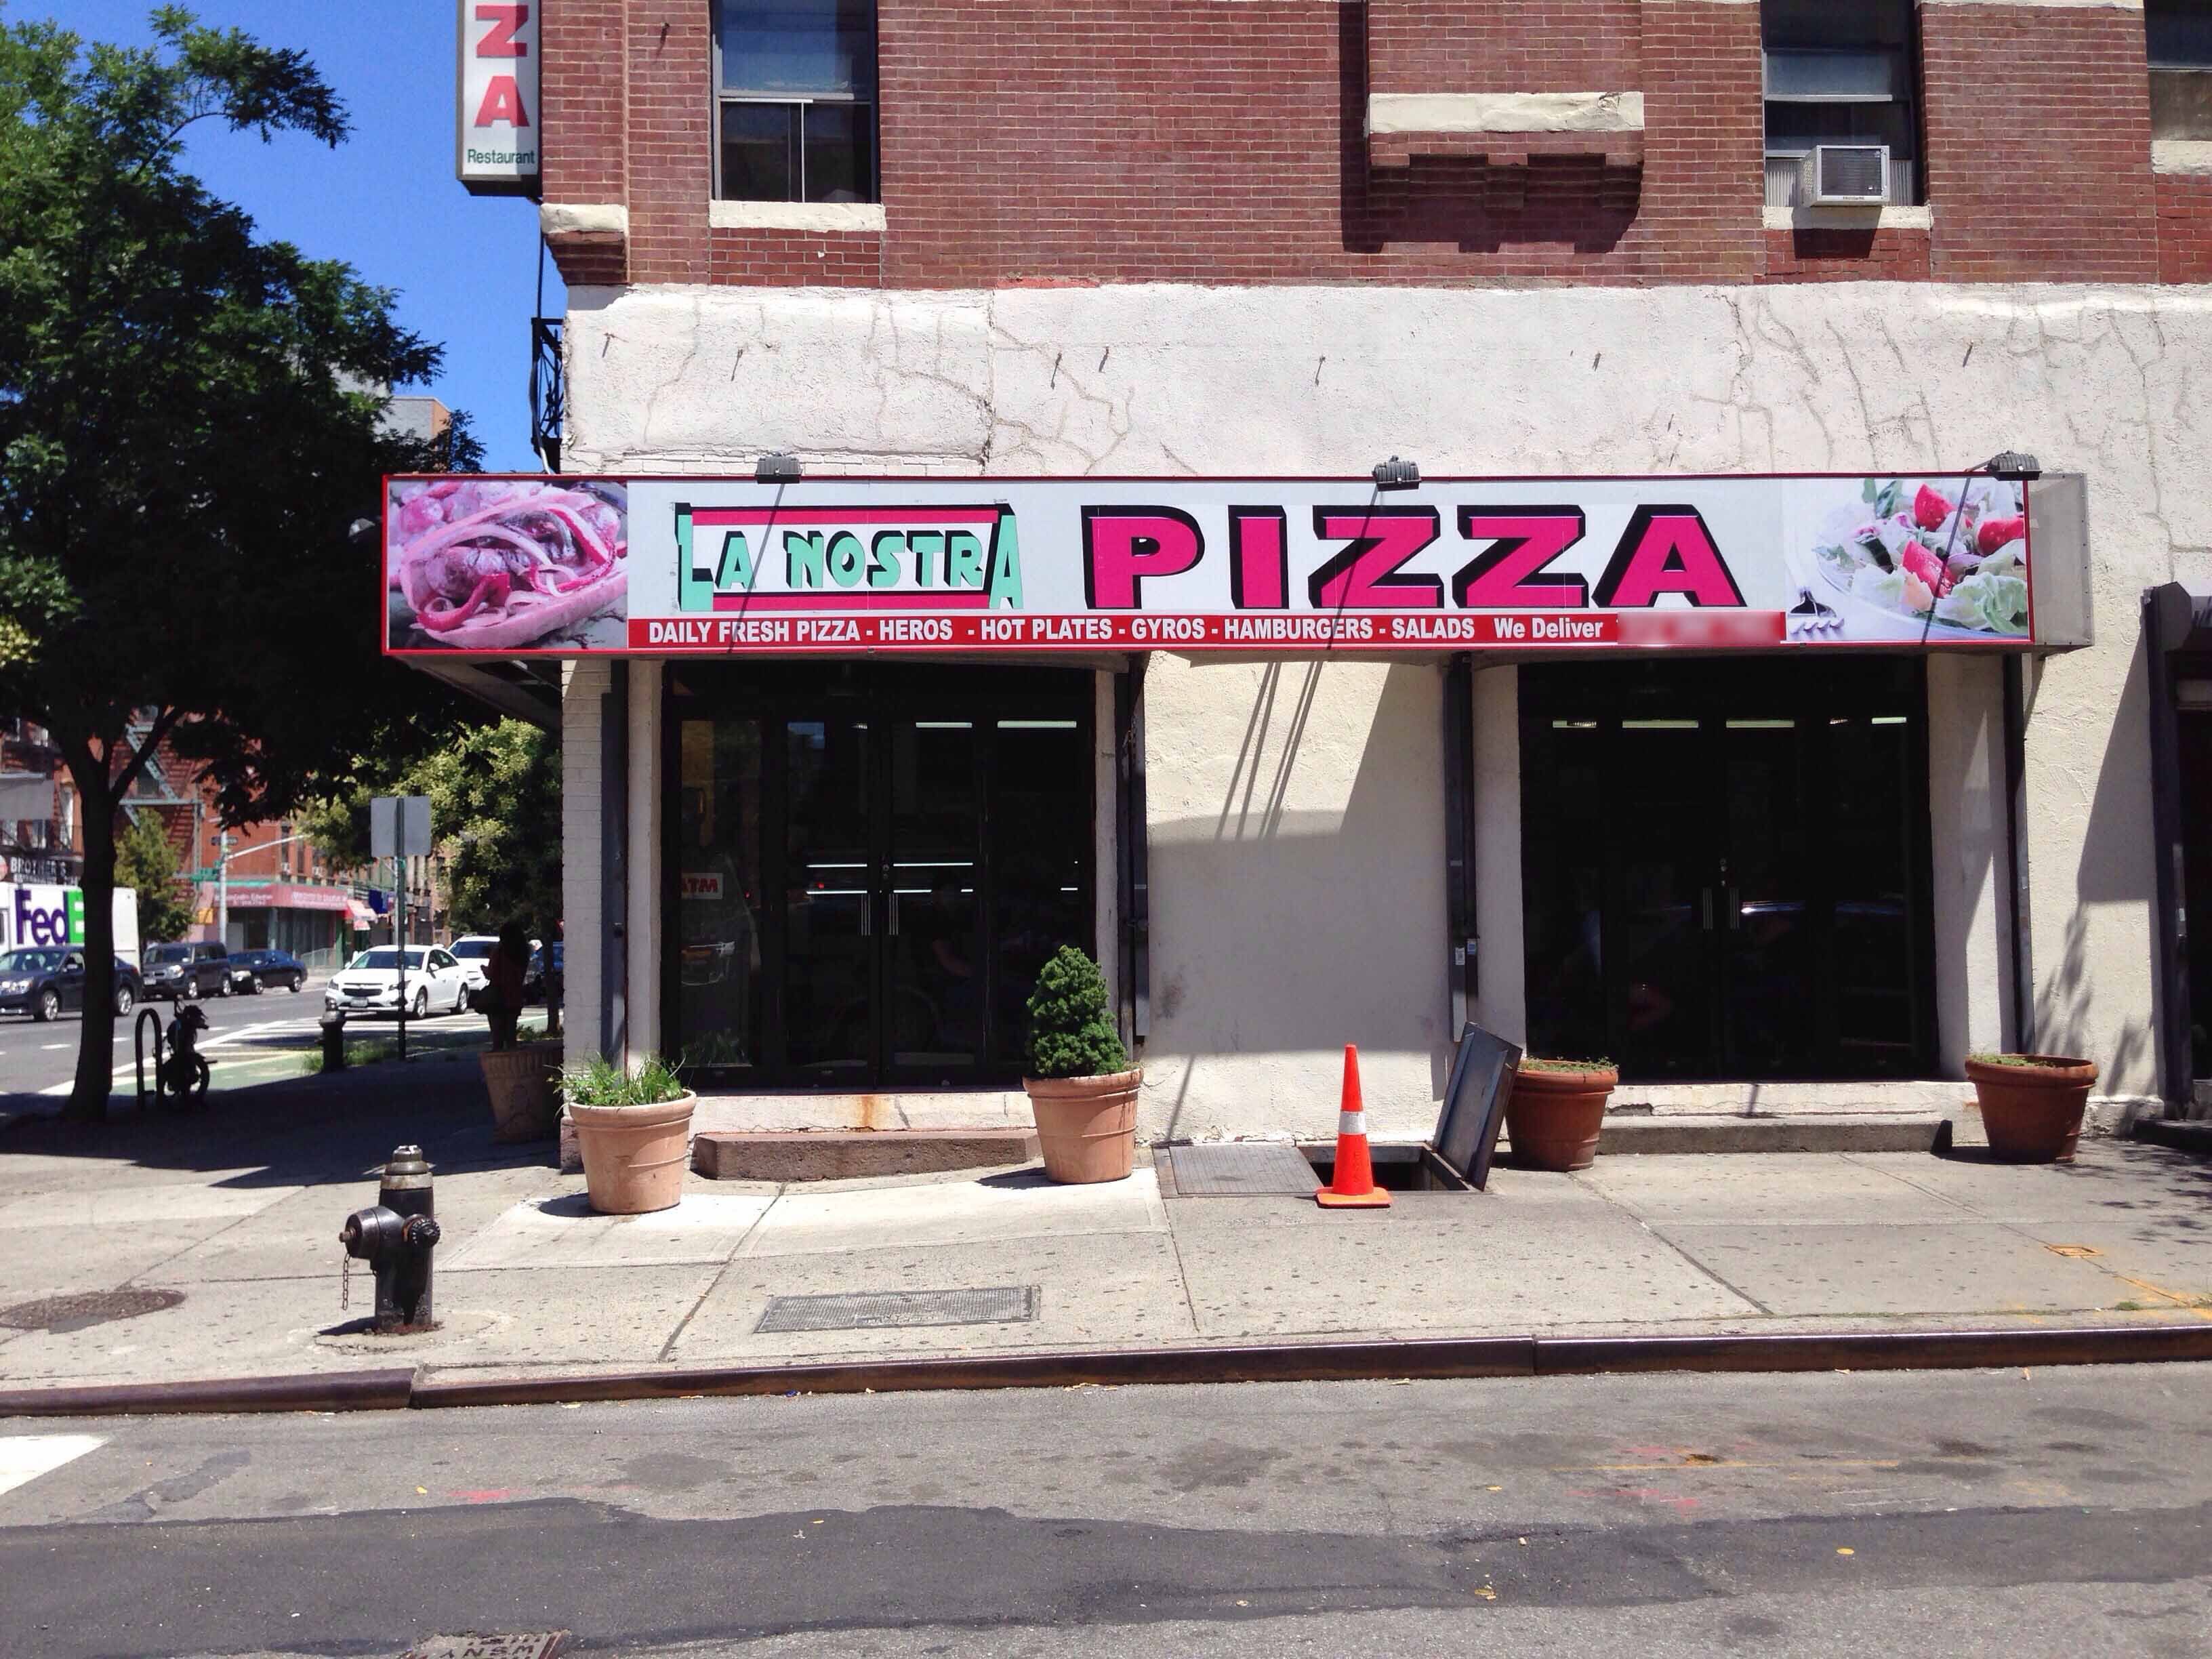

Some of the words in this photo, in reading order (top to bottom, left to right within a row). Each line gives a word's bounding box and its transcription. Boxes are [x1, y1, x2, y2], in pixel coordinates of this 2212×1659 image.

[468, 148, 535, 164] Restaurant
[674, 502, 757, 611] LA
[782, 503, 1024, 610] NOSTRA
[1080, 504, 1748, 609] PIZZA
[649, 621, 712, 643] DAILY
[718, 621, 790, 642] FRESH
[796, 619, 861, 642] PIZZA
[880, 619, 954, 641] HEROS
[981, 618, 1026, 640] HOT
[1032, 617, 1113, 640] PLATES
[1131, 617, 1192, 640] GYROS
[1224, 617, 1374, 640] HAMBURGERS
[1391, 617, 1475, 640] SALADS
[1494, 617, 1525, 639] We
[1532, 617, 1604, 639] Deliver
